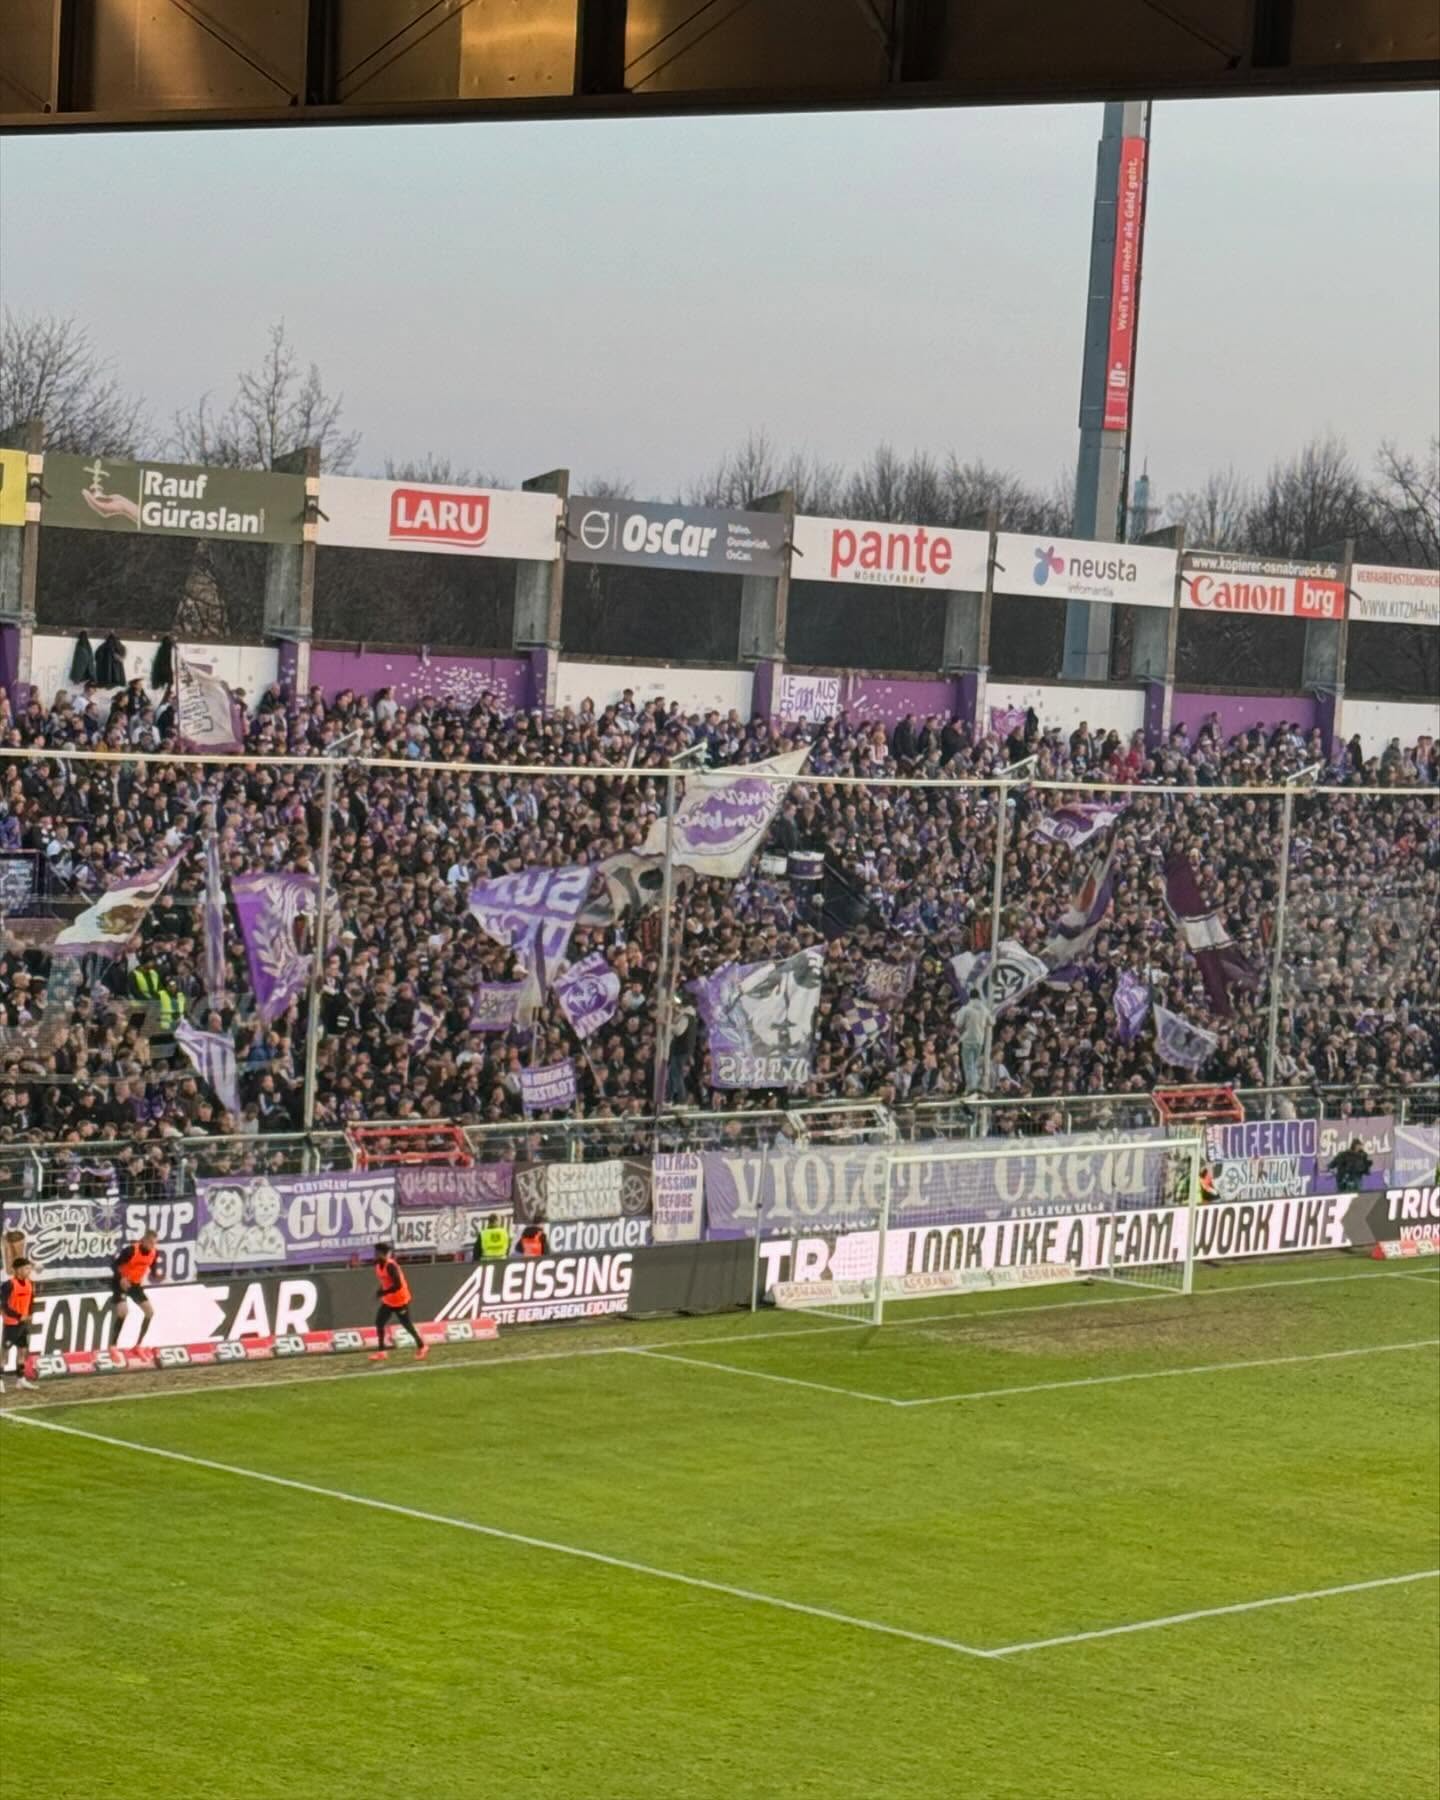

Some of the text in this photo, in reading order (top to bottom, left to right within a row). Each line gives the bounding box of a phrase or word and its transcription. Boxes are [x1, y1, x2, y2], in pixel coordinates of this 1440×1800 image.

[144, 471, 208, 499] Rauf
[142, 501, 259, 534] Güraslan
[397, 497, 483, 534] LARU
[622, 514, 717, 558] OsCar
[831, 528, 952, 579] pante
[1069, 558, 1137, 583] neusta
[1192, 556, 1337, 579] www.kopierer-osnabrueck.de
[1191, 575, 1286, 612] Canon
[1302, 582, 1336, 617] brg
[1222, 1120, 1316, 1160] INFERNO
[287, 1188, 395, 1240] GUYS
[994, 1219, 1058, 1268] LIKE
[1065, 1218, 1084, 1268] A
[1194, 1203, 1273, 1257] WORK
[484, 1252, 633, 1304] LEISSING
[517, 1299, 628, 1323] BERUFSBEKLEIDUNG
